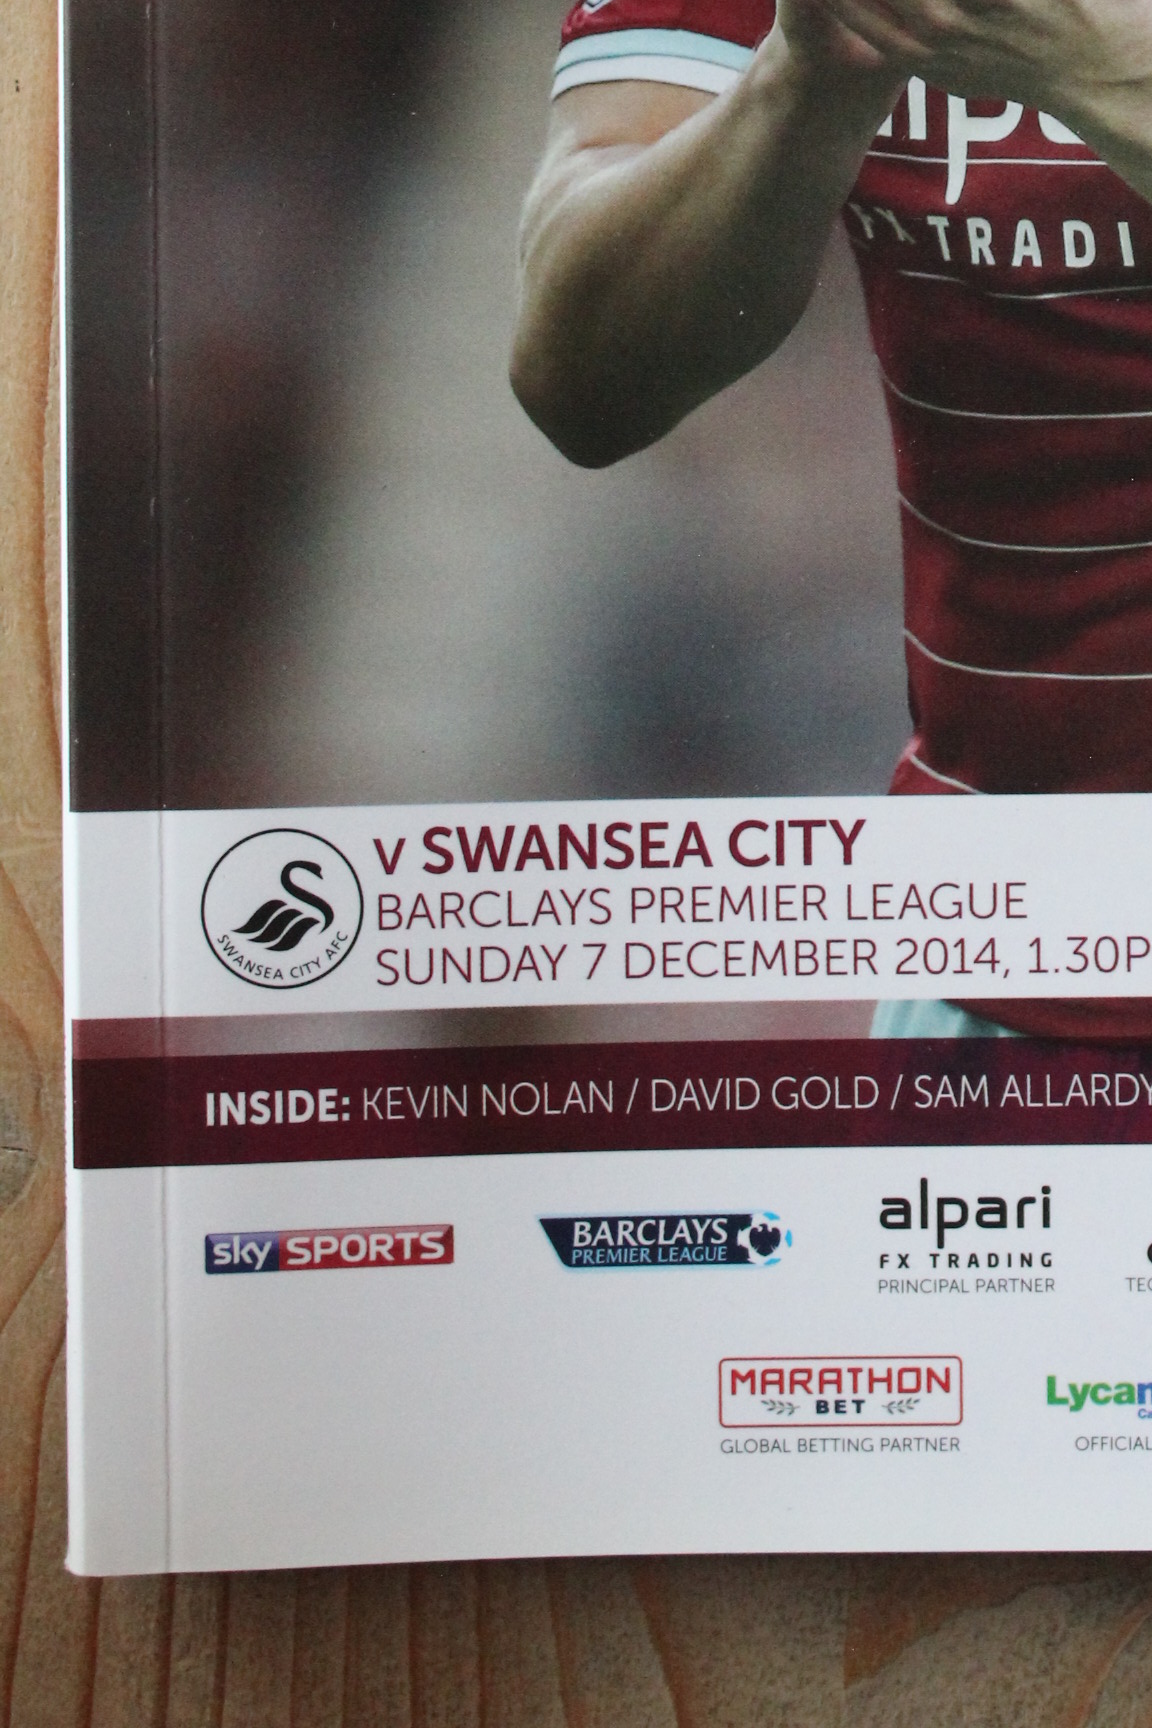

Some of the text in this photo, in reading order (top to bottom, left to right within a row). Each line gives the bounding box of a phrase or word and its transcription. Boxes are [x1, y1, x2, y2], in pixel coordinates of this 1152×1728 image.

[422, 821, 715, 874] SWANSEA
[729, 819, 866, 867] CITY
[378, 882, 1028, 930] BARCLAYS PREMIER LEAGUE
[217, 931, 348, 980] SWANSEA CITY AFC
[376, 944, 567, 986] SUNDAY
[583, 943, 607, 980] 7
[624, 939, 878, 980] DECEMBER
[896, 937, 1010, 978] 2014,
[205, 1088, 350, 1127] INSIDE:
[363, 1085, 468, 1120] KEVIN
[482, 1080, 613, 1116] NOLAN
[626, 1078, 638, 1114] /
[651, 1077, 761, 1112] DAVID
[772, 1076, 879, 1110] GOLD
[890, 1075, 903, 1110] /
[914, 1075, 989, 1109] SAM
[879, 1177, 1051, 1249] alpari
[213, 1230, 446, 1270] sky SPORTS
[571, 1219, 728, 1249] BARCLAYS
[571, 1245, 727, 1264] PREMIER LEAGUE
[879, 1252, 1053, 1269] FX TRADING
[878, 1278, 1055, 1294] PRINCIPAL PARTNER
[731, 1367, 950, 1395] MARATHON
[816, 1399, 866, 1414] BET
[720, 1437, 960, 1453] GLOBAL BETTING PARTNER
